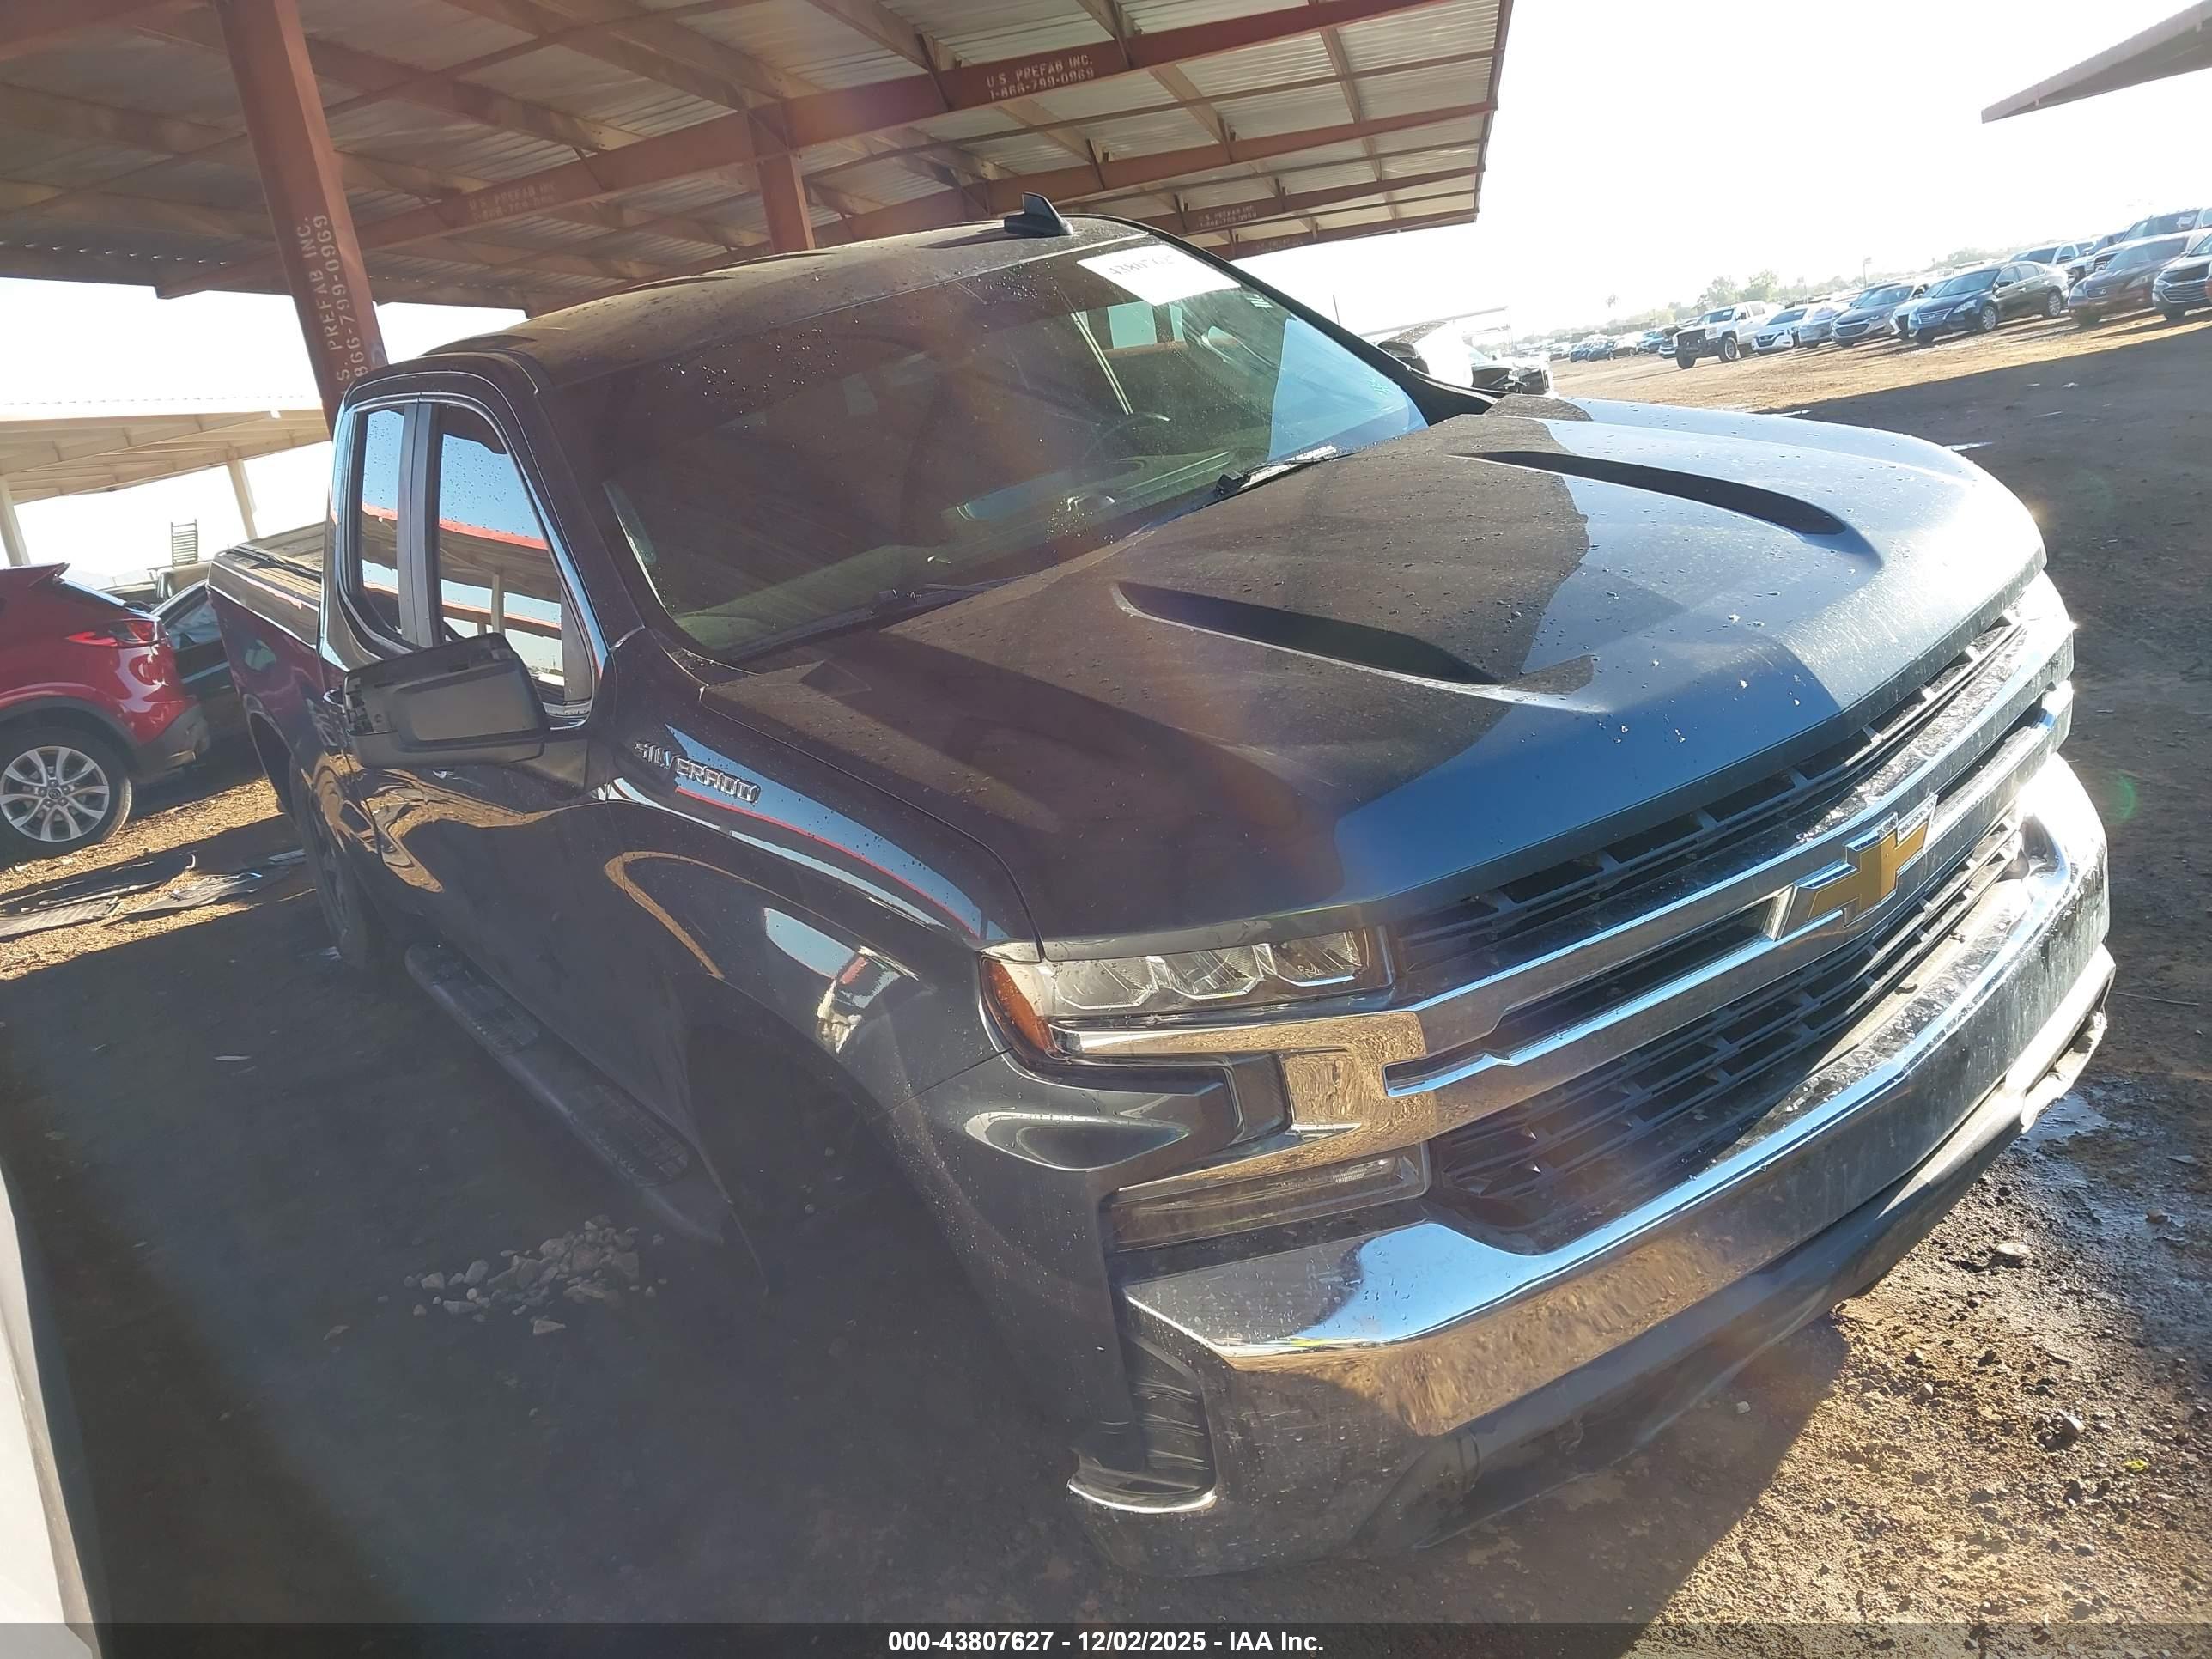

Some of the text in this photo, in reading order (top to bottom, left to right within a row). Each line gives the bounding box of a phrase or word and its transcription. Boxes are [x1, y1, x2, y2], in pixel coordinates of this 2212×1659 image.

[1016, 60, 1064, 82] PREFAB
[1068, 54, 1093, 68] INC.
[296, 217, 317, 258] INC.
[308, 269, 343, 350] PREFAB
[634, 742, 762, 803] SILVERADO
